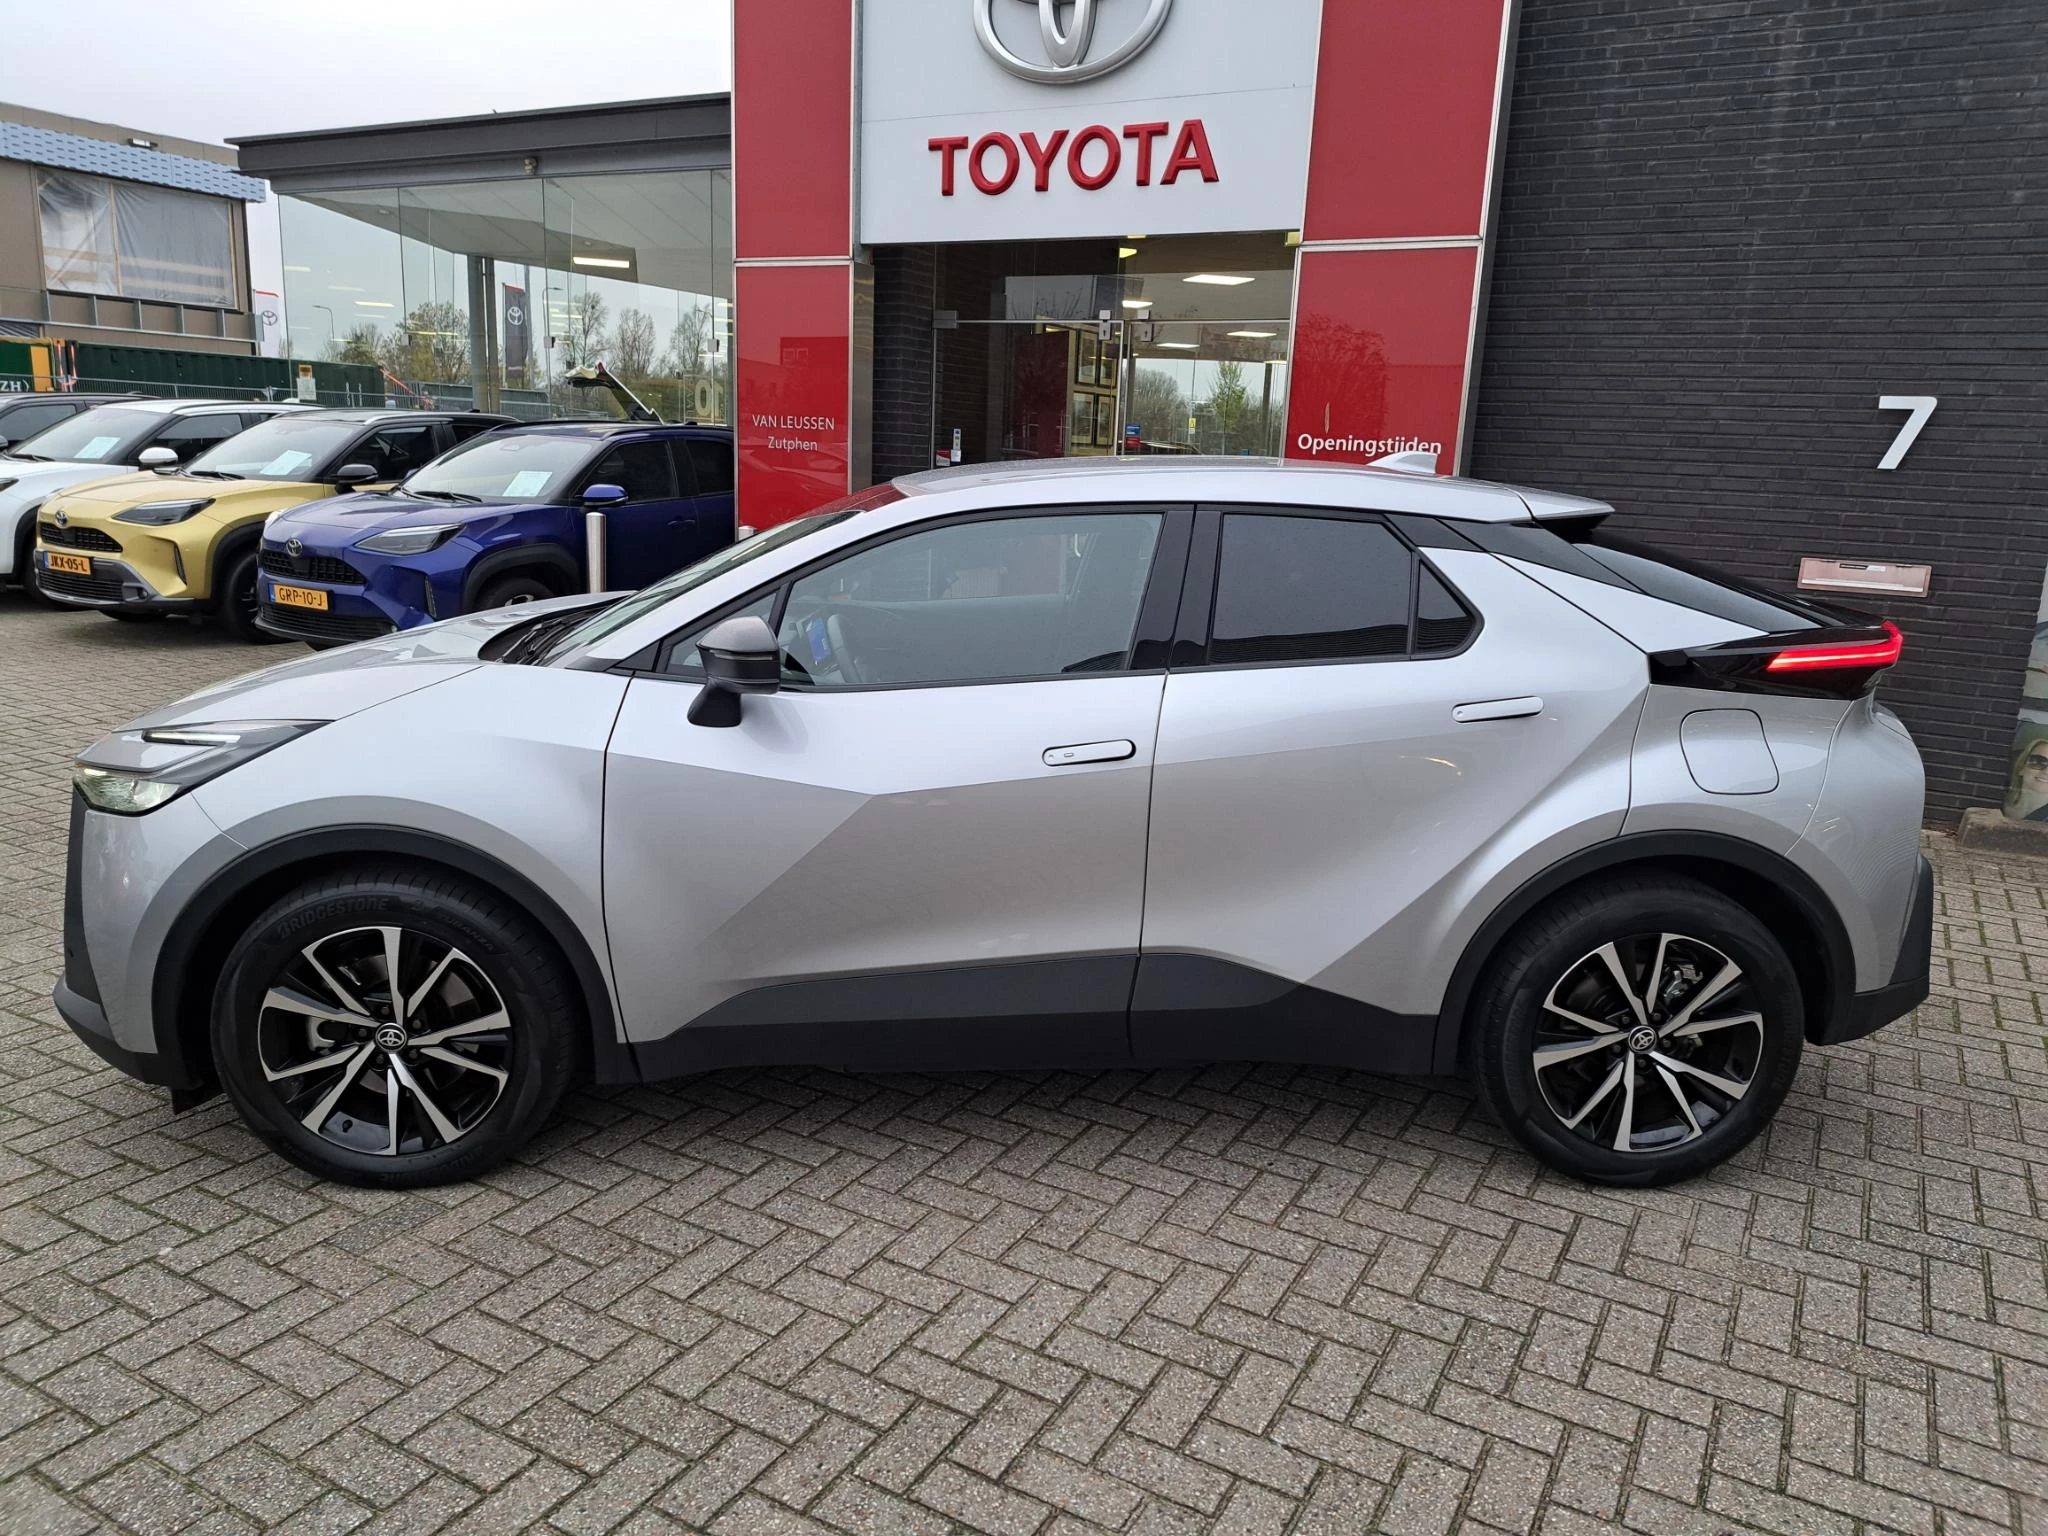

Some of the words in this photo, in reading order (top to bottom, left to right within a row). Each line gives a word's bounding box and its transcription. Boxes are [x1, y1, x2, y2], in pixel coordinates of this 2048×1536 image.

[928, 119, 1219, 196] TOYOTA
[752, 414, 777, 428] VAN
[780, 415, 835, 430] LEUSSEN
[1877, 396, 1938, 469] 7
[768, 436, 818, 453] Zutphen
[1297, 433, 1442, 457] Openingstijden
[50, 554, 88, 572] JKX-05-L
[278, 587, 323, 607] GRP-10-J
